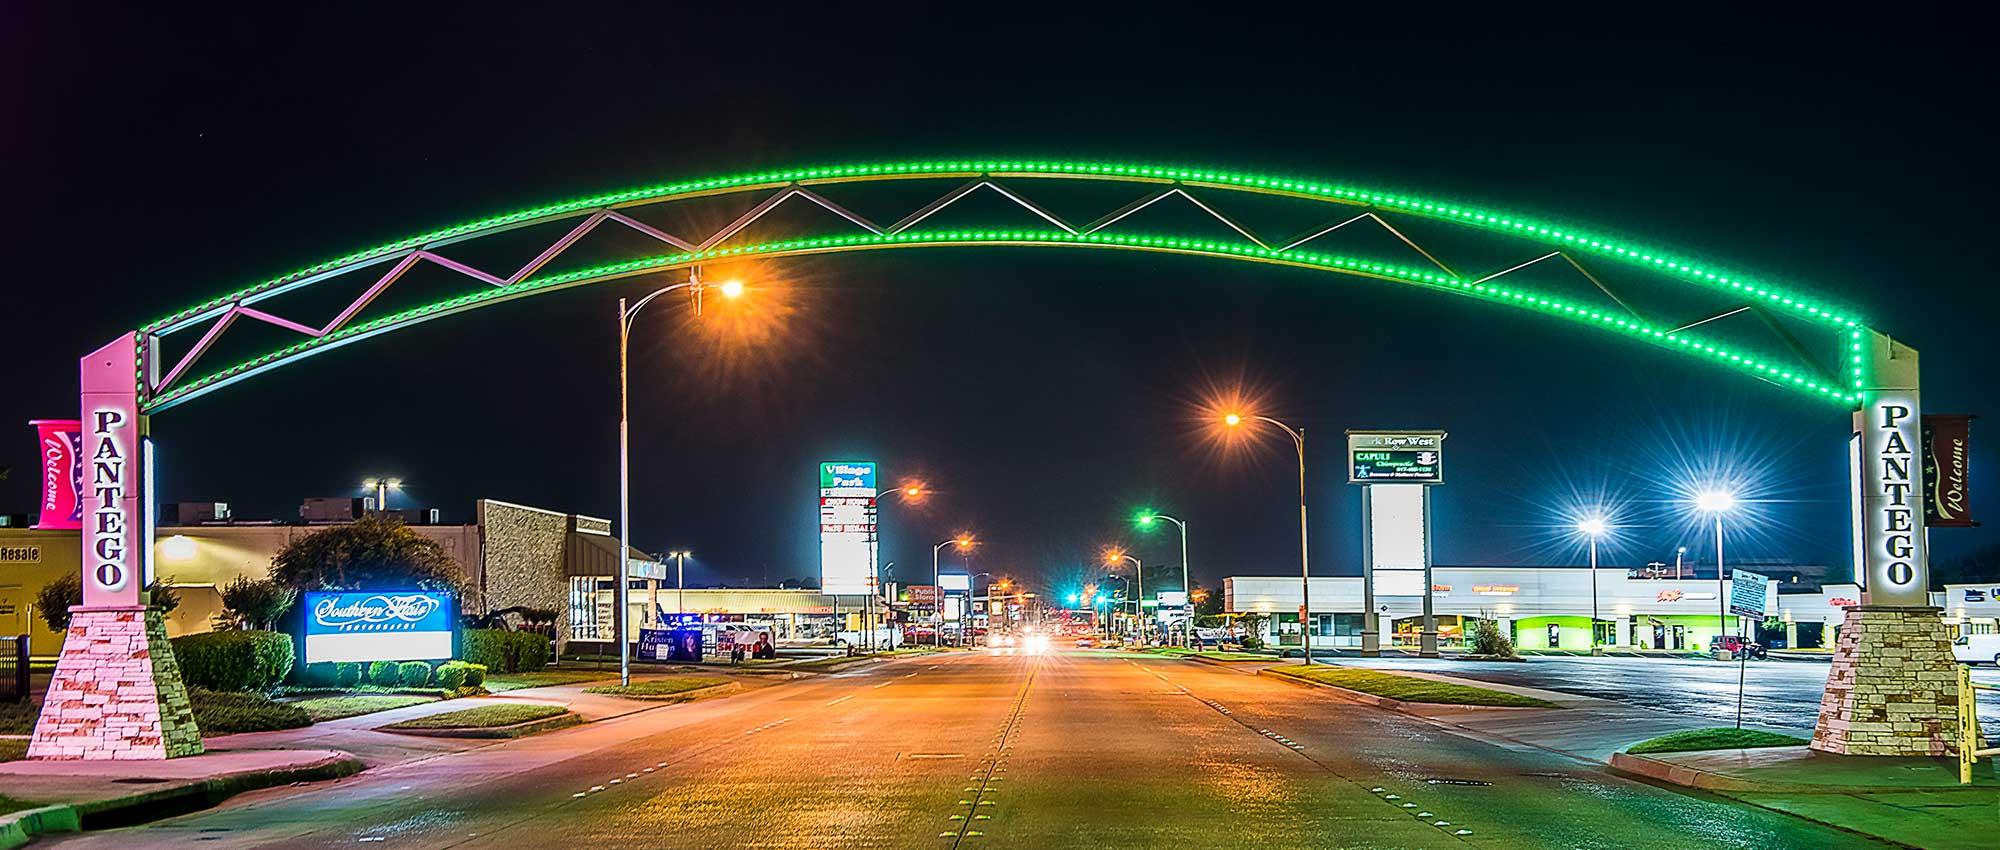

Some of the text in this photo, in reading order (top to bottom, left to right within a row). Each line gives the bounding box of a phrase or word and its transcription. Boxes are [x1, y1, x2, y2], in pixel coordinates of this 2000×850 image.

[1384, 437, 1407, 445] Row
[1407, 437, 1434, 445] West
[44, 438, 63, 512] Welcome
[826, 465, 871, 476] Village
[1948, 438, 1964, 513] Welcome
[833, 477, 864, 487] Park
[94, 411, 122, 586] PANTEGO
[1881, 406, 1913, 585] PANTEGO
[0, 548, 38, 560] Resale
[315, 596, 385, 625] Southern
[644, 634, 674, 643] Kristen
